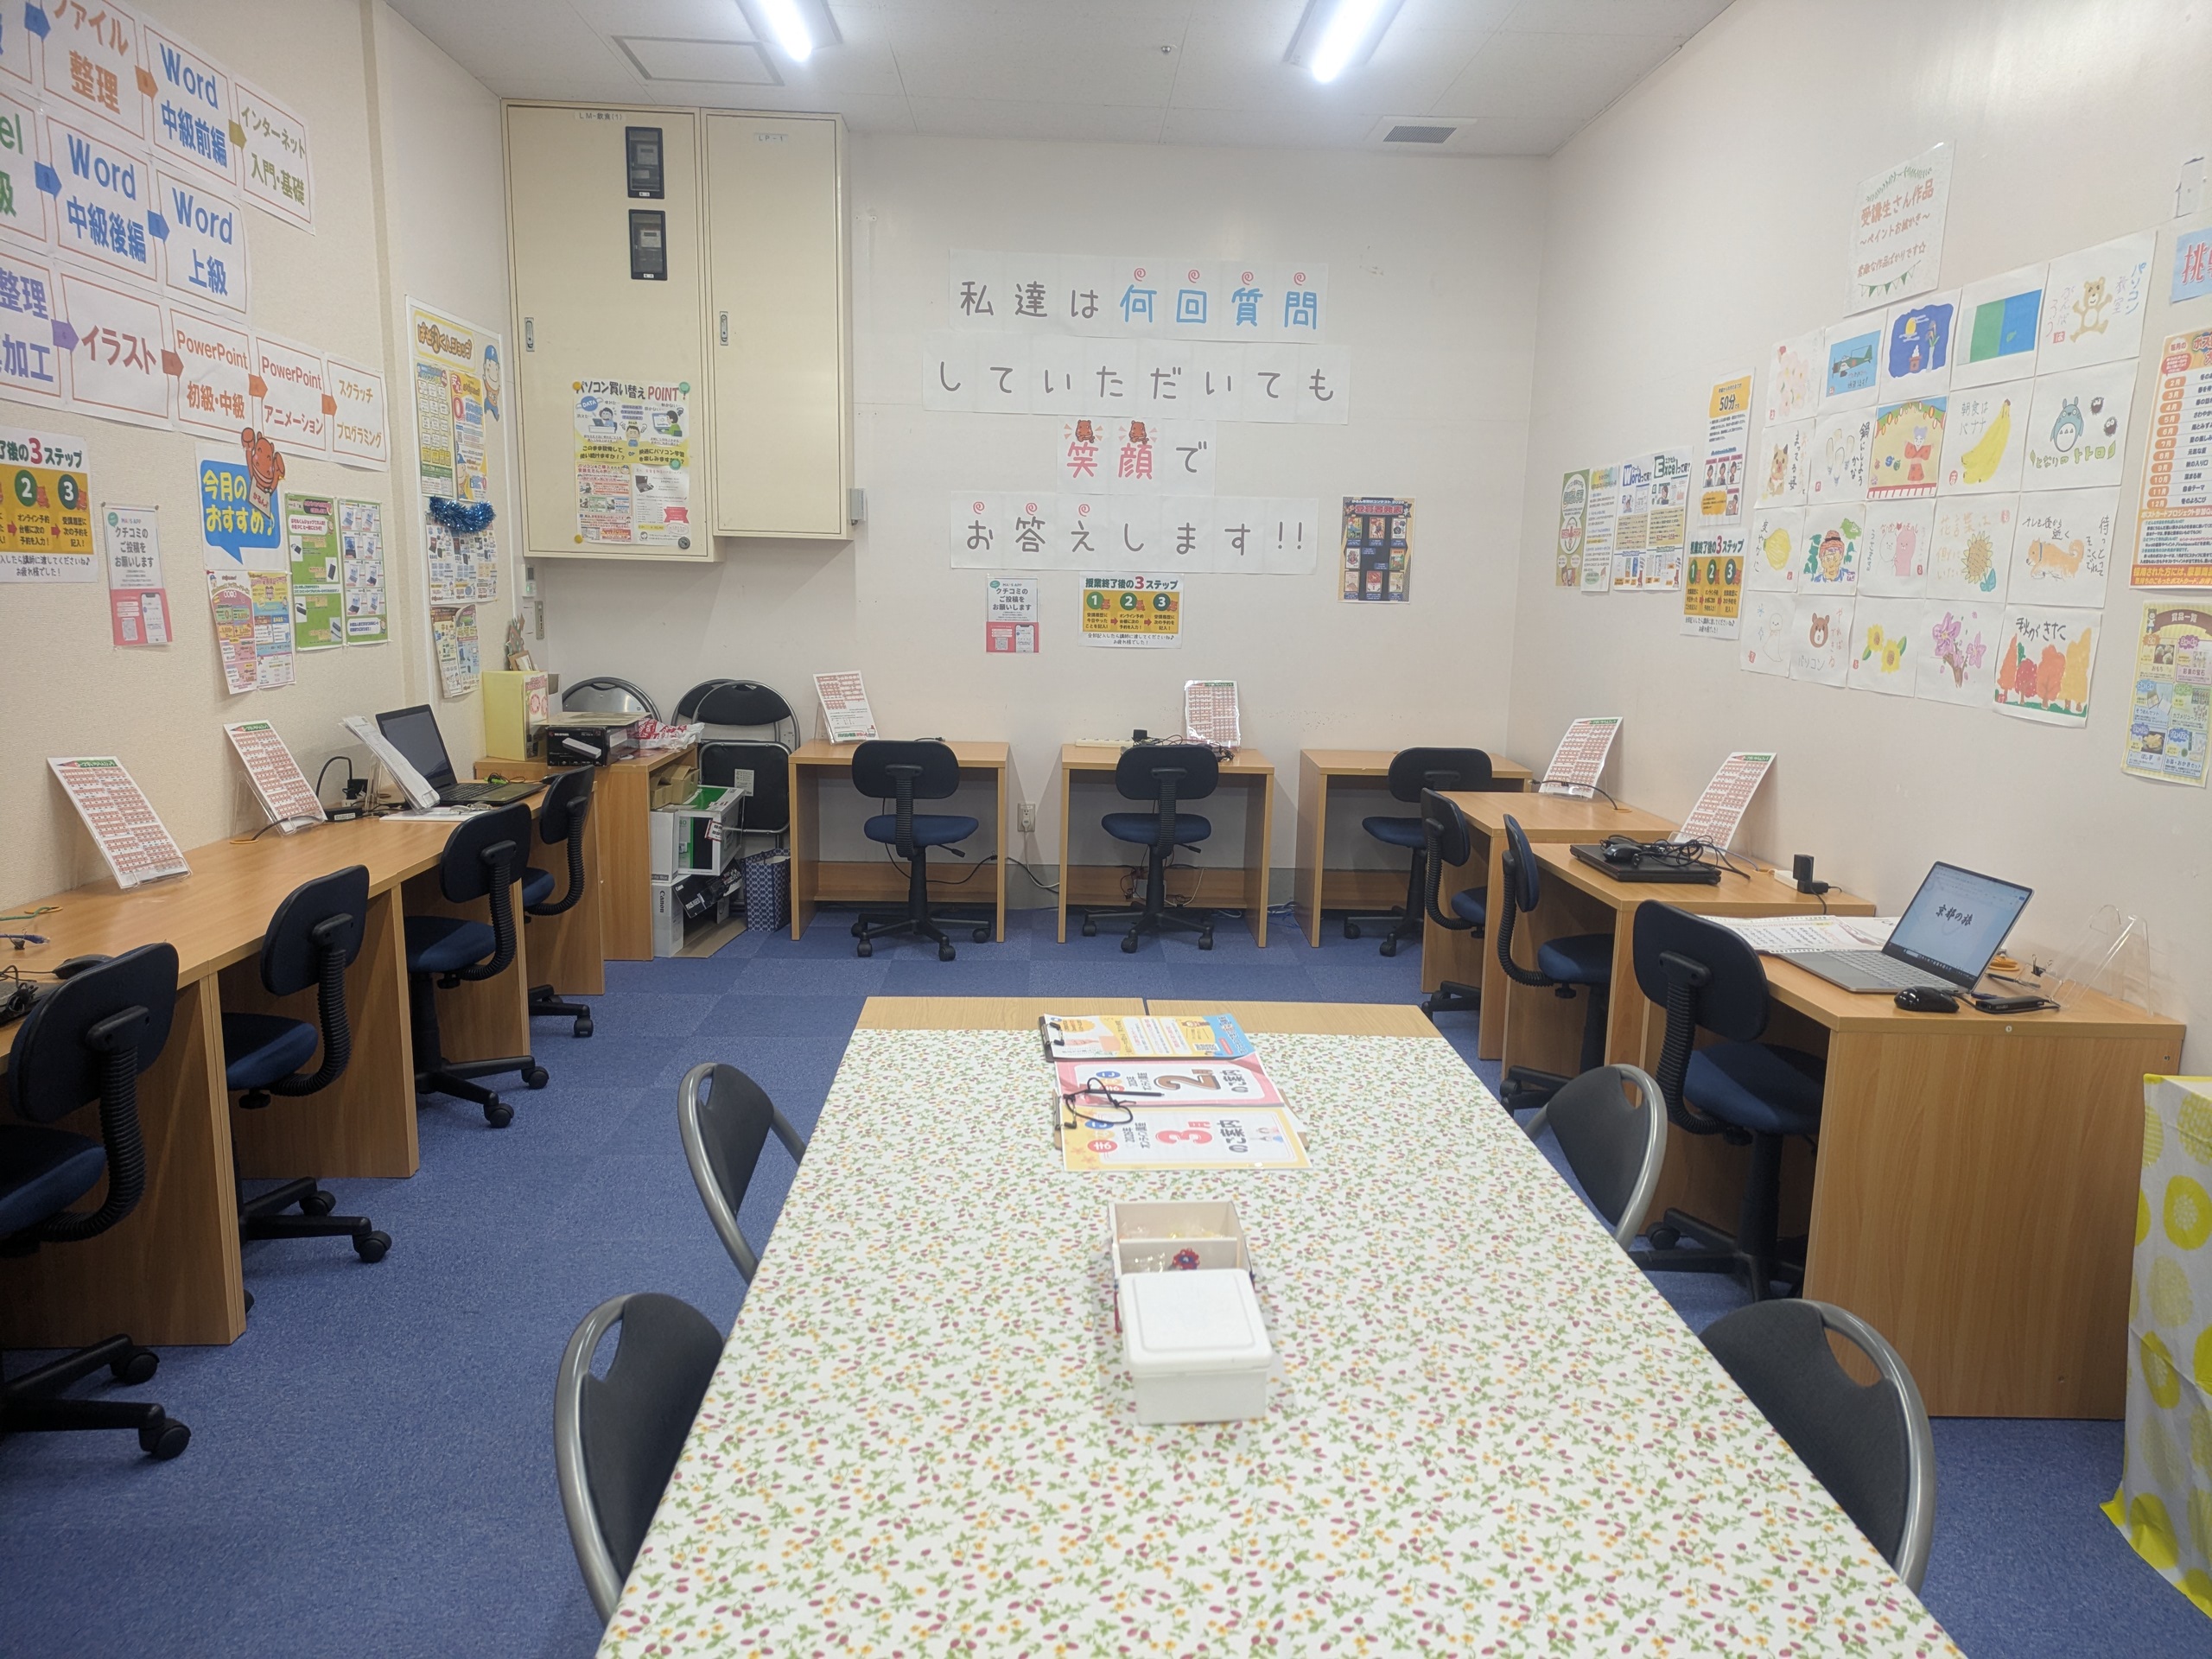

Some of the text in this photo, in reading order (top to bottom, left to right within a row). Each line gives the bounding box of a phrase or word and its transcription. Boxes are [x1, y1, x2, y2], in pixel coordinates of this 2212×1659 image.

[69, 50, 120, 115] 整理
[159, 42, 219, 110] Word
[161, 99, 227, 168] 中級前編
[241, 106, 305, 160] インターネット
[67, 133, 137, 200] Word
[251, 152, 305, 207] 入門・基礎
[1861, 179, 1935, 228] 受講生さん作品
[172, 187, 233, 246] Word
[67, 195, 147, 264] 中級後編
[188, 249, 229, 297] 上級
[2182, 241, 2212, 285] 挑
[2125, 262, 2147, 315] パソコン
[960, 280, 1319, 330] 私達は何回質問
[0, 333, 54, 383] 加工
[81, 325, 157, 375] イラスト
[176, 330, 249, 371] PowerPoint
[262, 356, 322, 390] PowerPoint
[939, 361, 1334, 402] していただいても
[2170, 378, 2181, 387] 2月
[187, 380, 245, 420] 初級・中級
[338, 378, 373, 404] スクラッチ
[576, 380, 645, 399] パソコン買い替え
[2168, 391, 2179, 399] 3月
[582, 399, 597, 408] DATA
[1961, 400, 1989, 416] 朝食は
[264, 404, 324, 435] アニメーション
[1959, 420, 1986, 435] バナナ
[2164, 415, 2175, 423] 5月
[337, 422, 382, 449] プログラミング
[1066, 441, 1208, 480] 笑顔で
[2159, 451, 2170, 460] 8月
[20, 477, 33, 498] 2
[63, 480, 74, 501] 3
[203, 469, 247, 501] 今月の
[2152, 487, 2166, 496] 11月
[2154, 475, 2168, 484] 10月
[2152, 499, 2164, 508] 12月
[115, 527, 148, 539] クチコミの
[966, 516, 1303, 556] お答えします!!
[120, 541, 146, 554] ご投稿を
[115, 556, 154, 569] お願いします
[1691, 564, 1696, 577] 1
[1708, 564, 1714, 578] 2
[1726, 563, 1733, 578] 3
[1085, 575, 1179, 590] 授業終了後の3ステップ
[1091, 595, 1098, 605] 1
[1125, 596, 1133, 606] 2
[1158, 597, 1166, 607] 3
[2016, 617, 2067, 641] 秋がきた
[1798, 654, 1825, 671] パソコン
[1936, 904, 1973, 926] 京都の旅
[1154, 1069, 1222, 1090] 2月
[1220, 1069, 1249, 1093] のご案内
[1135, 1122, 1150, 1149] オンライン講座
[1154, 1121, 1213, 1145] 3月
[1217, 1120, 1249, 1153] のご案内
